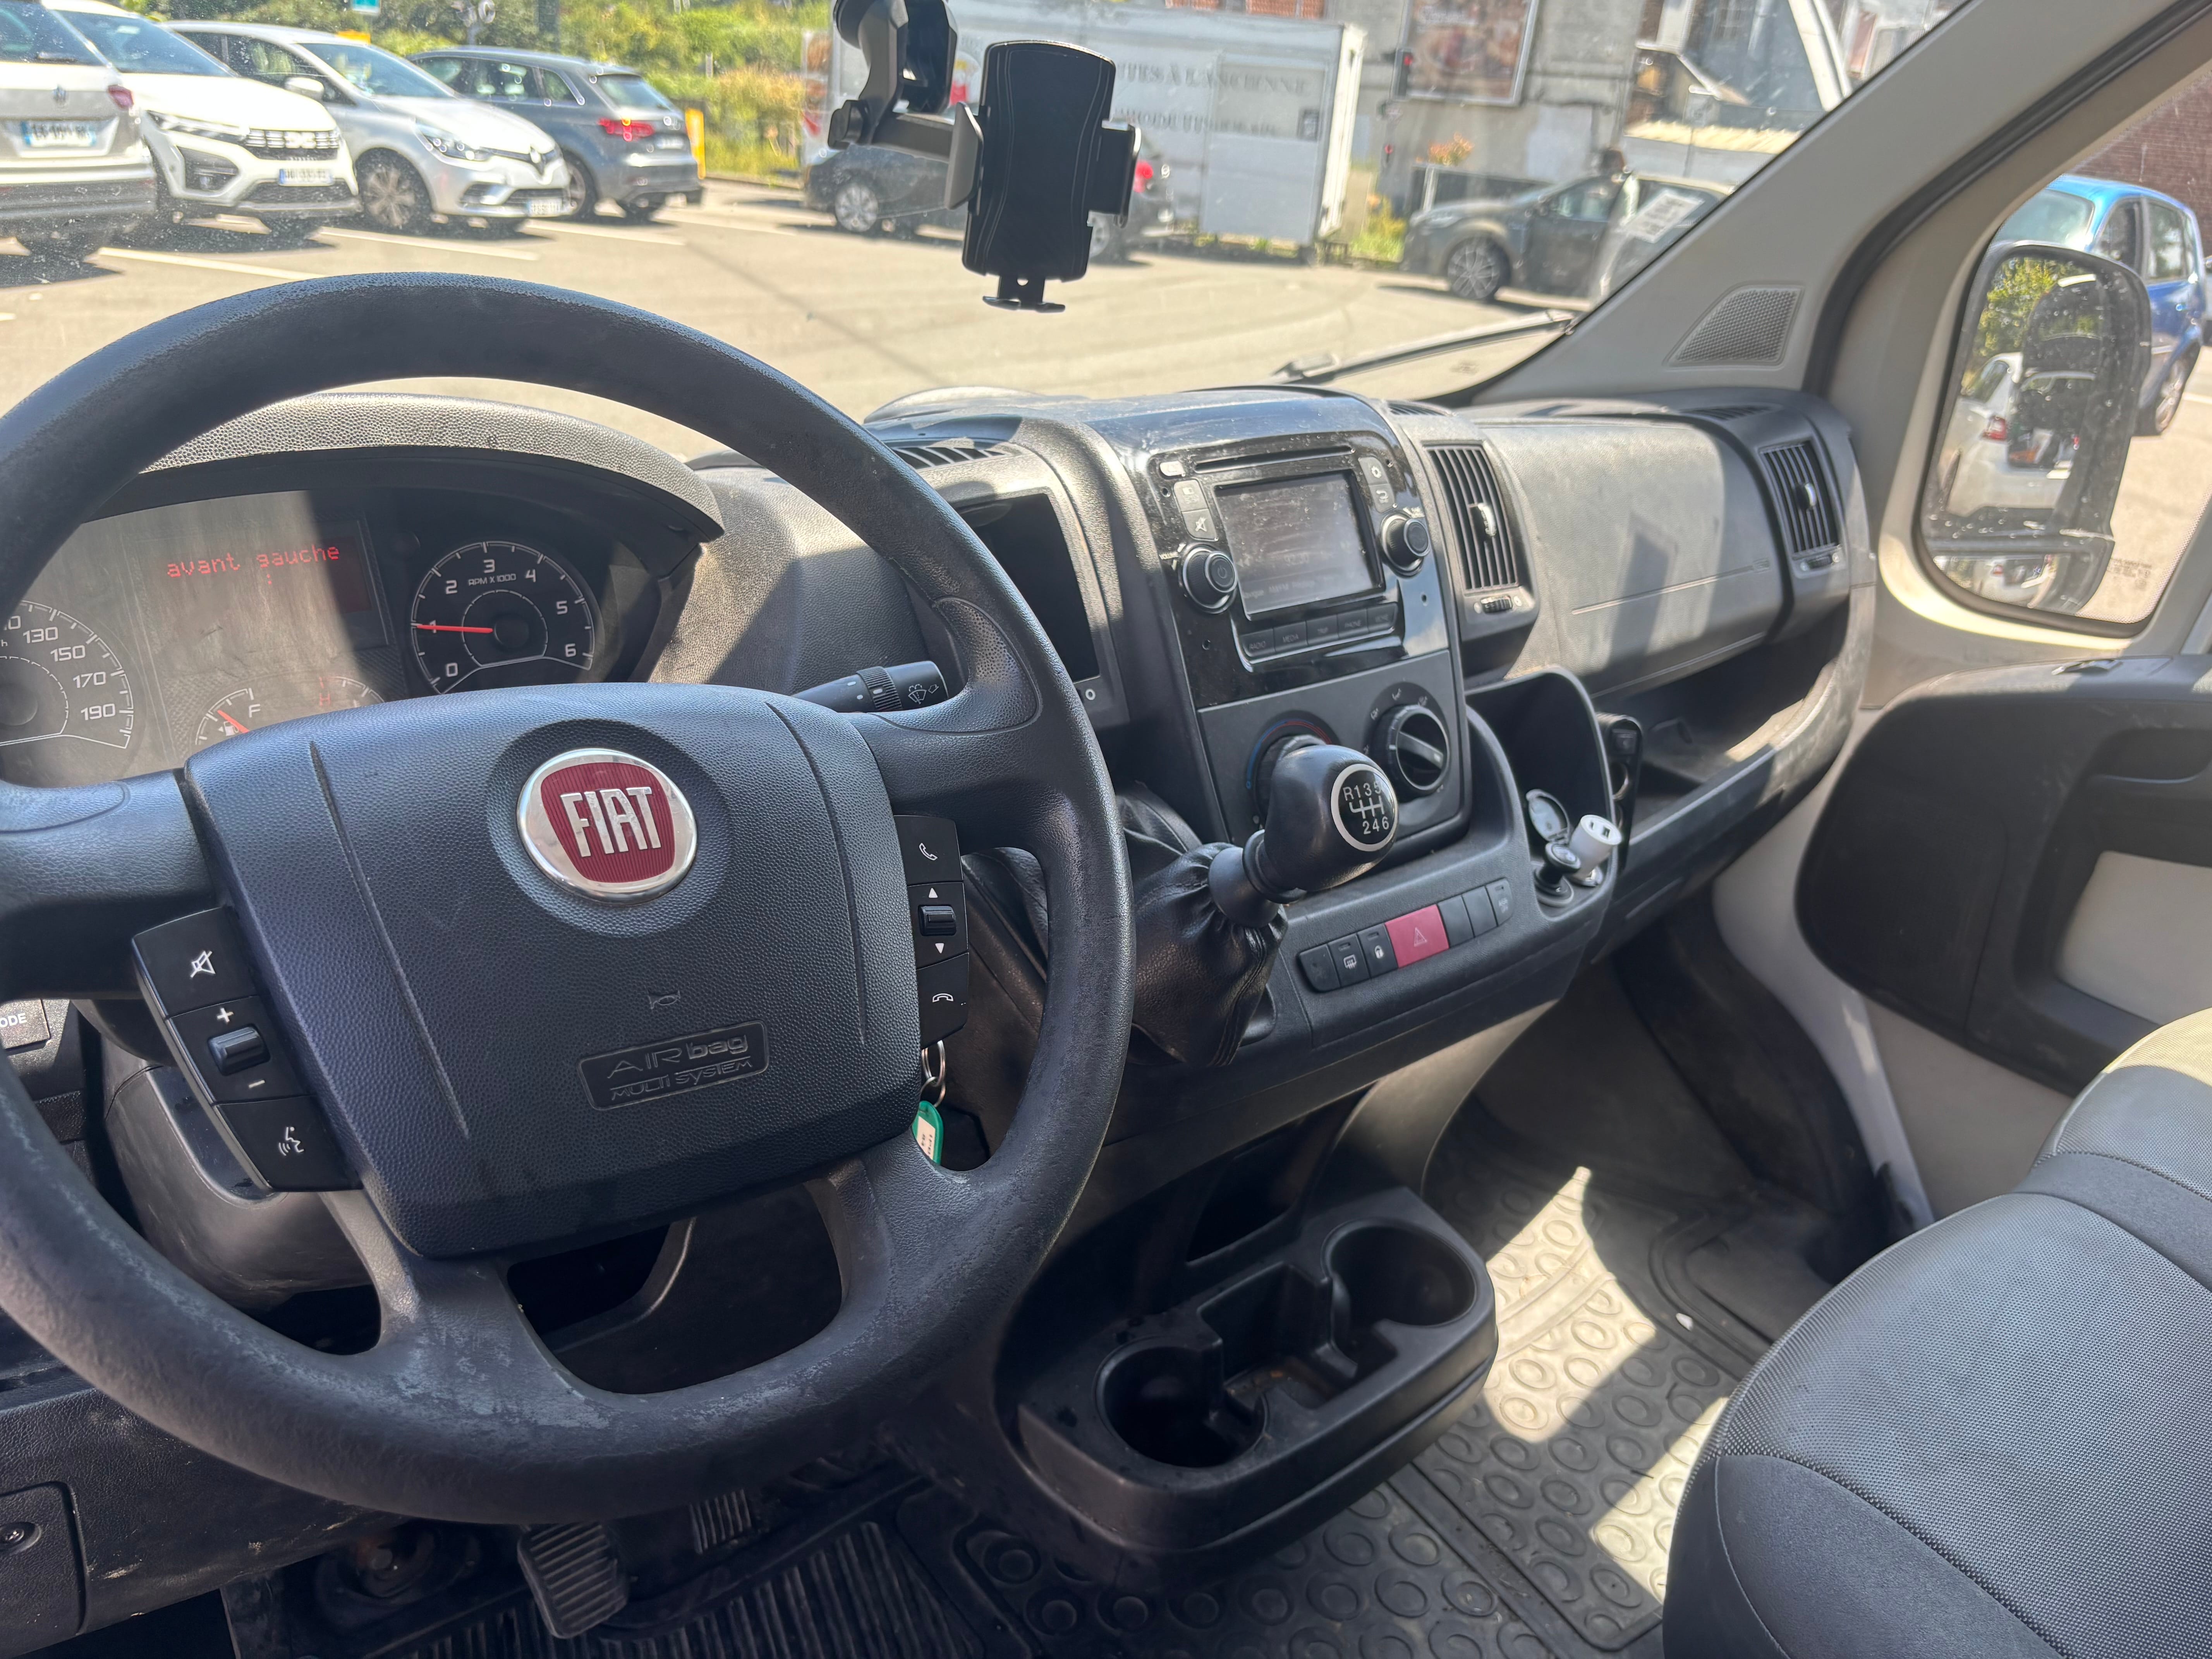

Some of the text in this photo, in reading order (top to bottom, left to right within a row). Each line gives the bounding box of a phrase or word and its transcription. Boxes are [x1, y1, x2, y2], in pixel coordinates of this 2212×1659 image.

[167, 545, 339, 577] avant gauche
[483, 559, 495, 573] 3
[468, 577, 488, 586] RPM
[497, 573, 517, 582] 1000
[525, 569, 536, 582] 4
[446, 580, 457, 594] 2
[556, 600, 568, 615] 5
[23, 627, 58, 644] 130
[50, 645, 86, 662] 150
[565, 643, 576, 657] 6
[445, 663, 458, 677] 0
[73, 672, 106, 688] 170
[319, 692, 331, 707] H
[81, 703, 116, 720] 190
[248, 704, 261, 718] F
[1343, 781, 1382, 801] R 1 3 5
[560, 787, 661, 857] FIAT
[1362, 816, 1389, 835] 2 4 6
[0, 1012, 27, 1028] ODE
